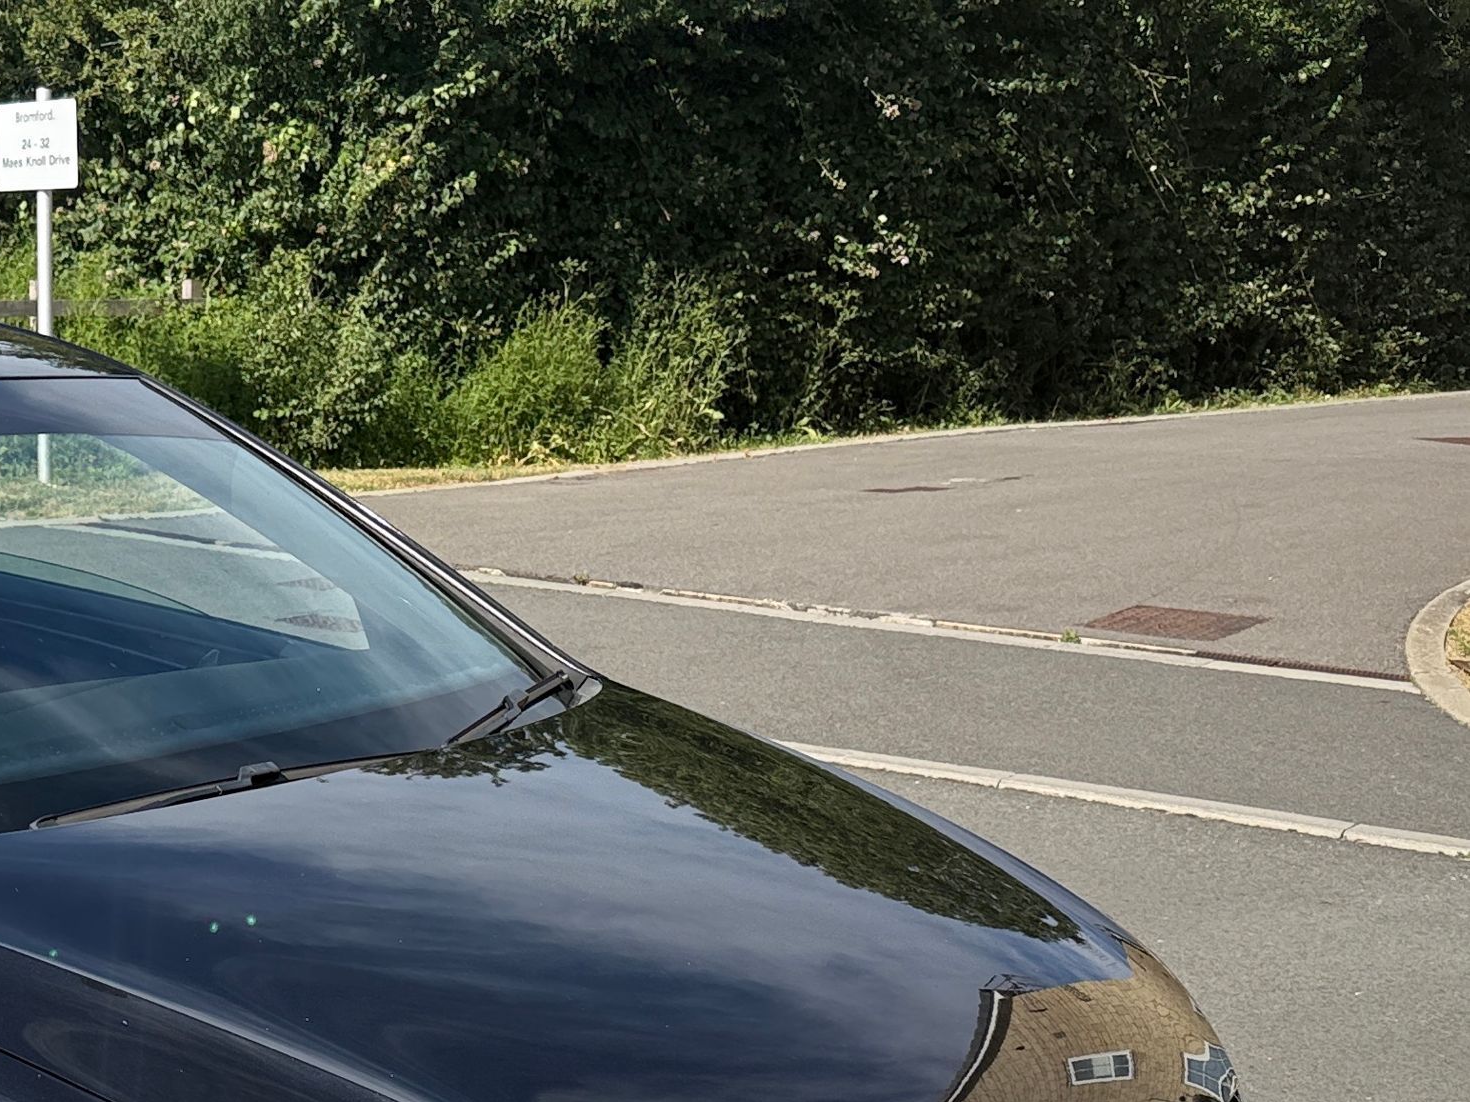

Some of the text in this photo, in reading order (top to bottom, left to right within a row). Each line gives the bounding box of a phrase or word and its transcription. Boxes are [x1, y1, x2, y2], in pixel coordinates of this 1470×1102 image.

[21, 139, 31, 150] 24
[40, 137, 50, 149] 32
[26, 155, 46, 167] Knoll
[49, 154, 71, 166] Drive
